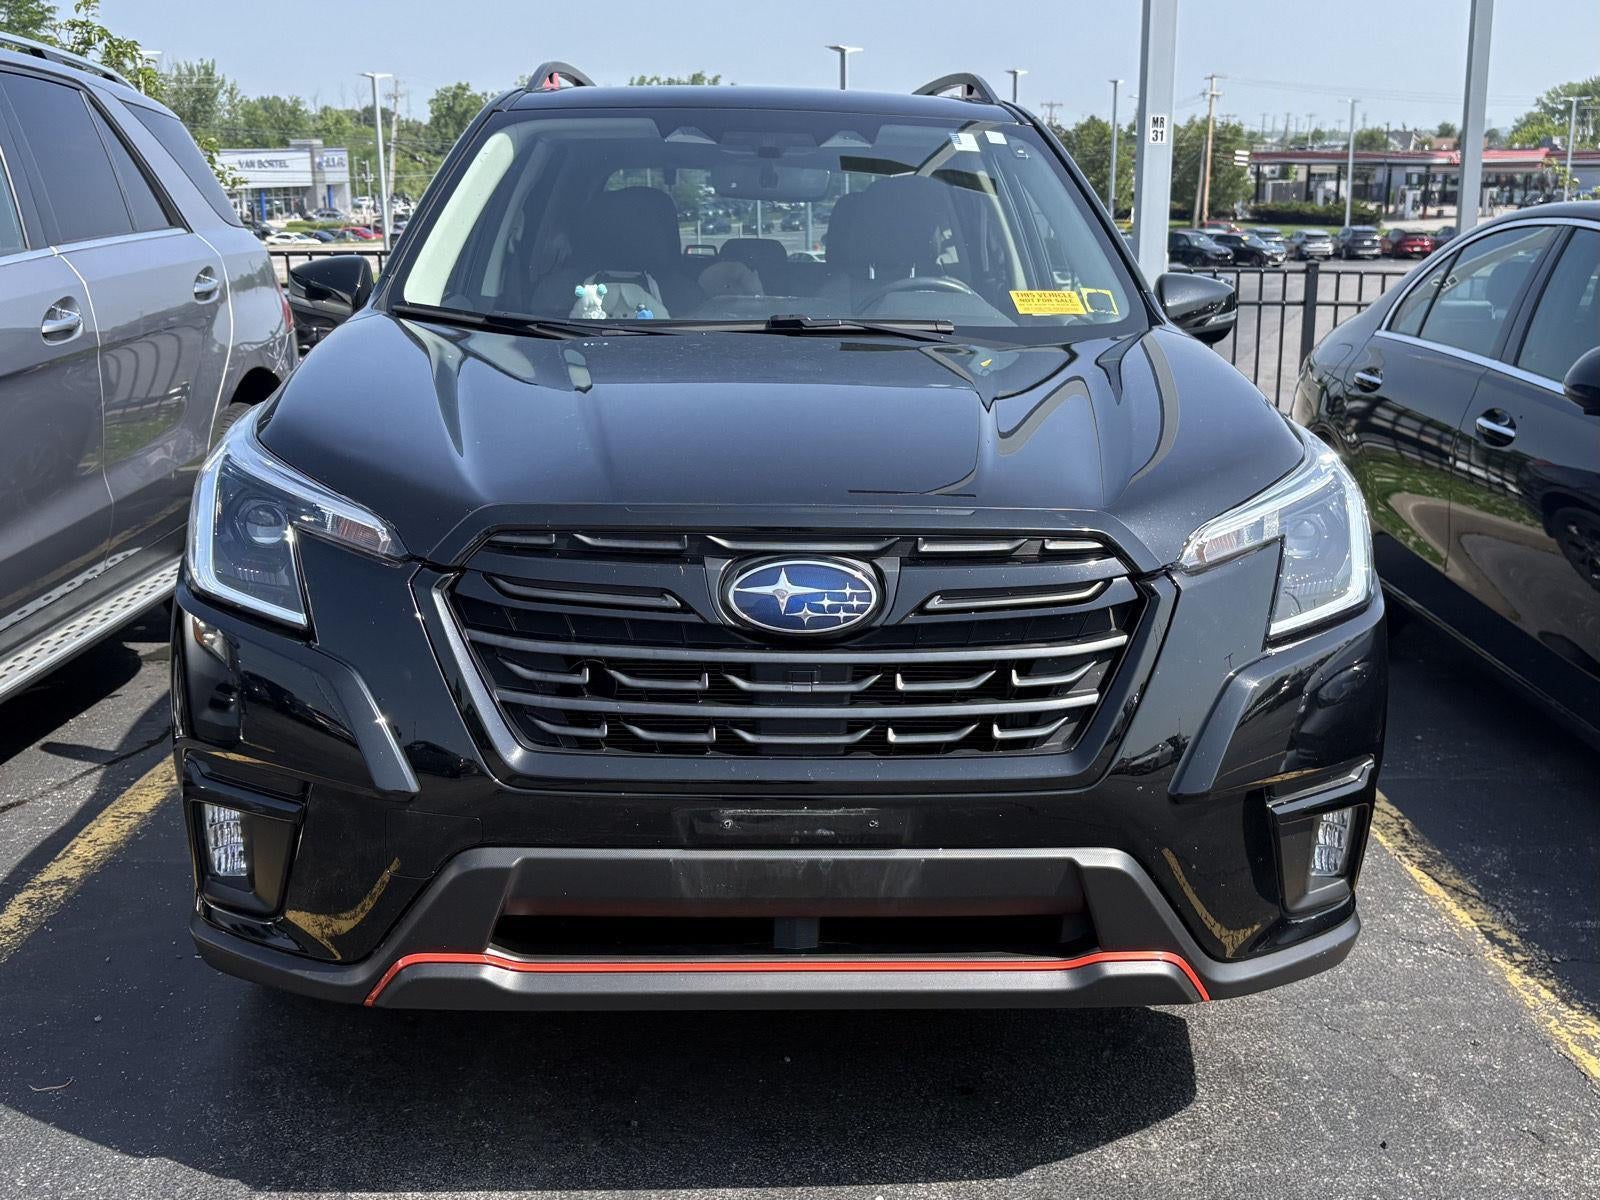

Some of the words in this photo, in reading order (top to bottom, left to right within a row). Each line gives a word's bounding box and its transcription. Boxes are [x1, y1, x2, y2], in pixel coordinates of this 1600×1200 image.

[1151, 116, 1165, 128] MR
[1152, 129, 1164, 142] 31
[238, 159, 256, 169] VAN
